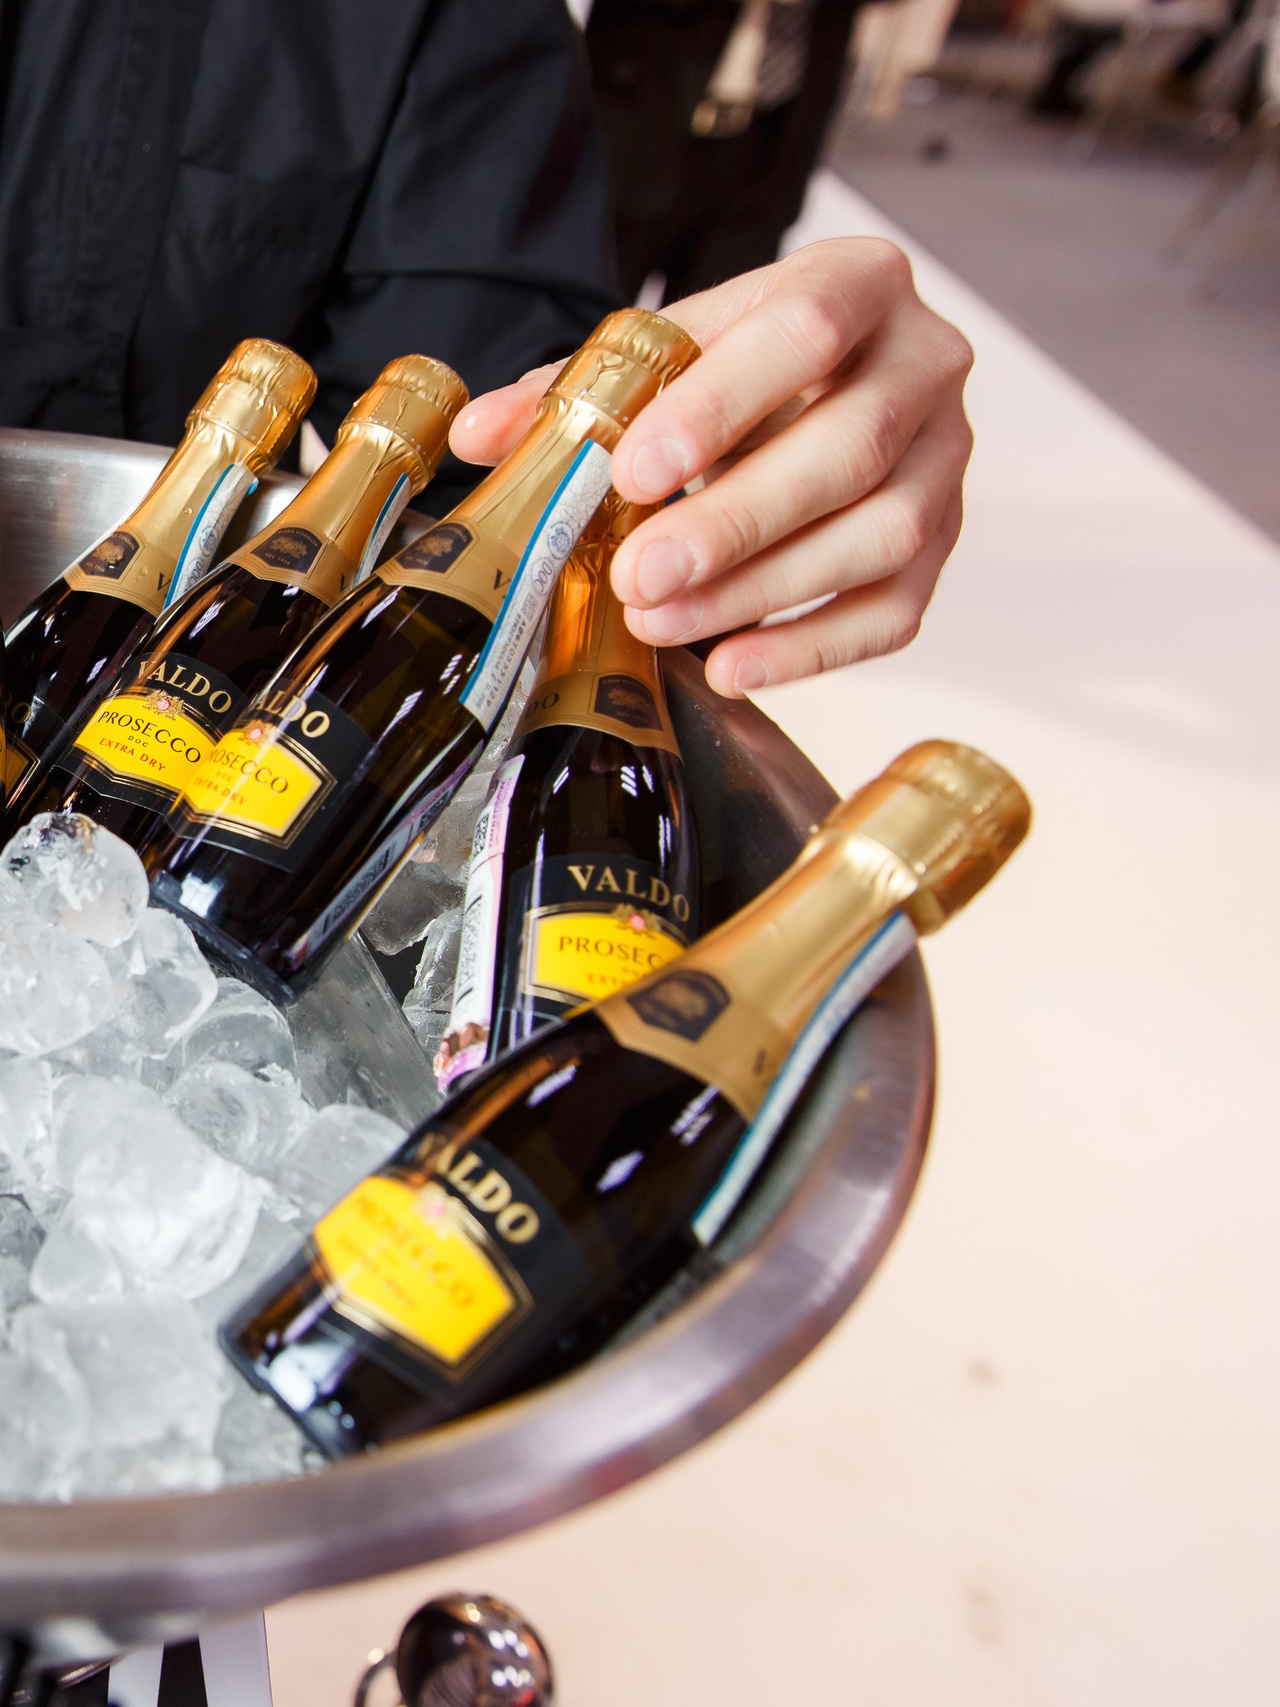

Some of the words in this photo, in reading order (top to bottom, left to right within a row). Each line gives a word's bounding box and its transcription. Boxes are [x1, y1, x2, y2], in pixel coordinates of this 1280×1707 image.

[137, 659, 233, 714] VALDO
[253, 690, 331, 739] ALDO
[97, 710, 202, 764] PROSECCO
[98, 736, 136, 758] EXTRA
[139, 752, 168, 773] DRY
[127, 734, 150, 749] DOC
[221, 785, 249, 806] DRY
[566, 864, 691, 923] VALDO
[559, 934, 664, 970] PROSEC
